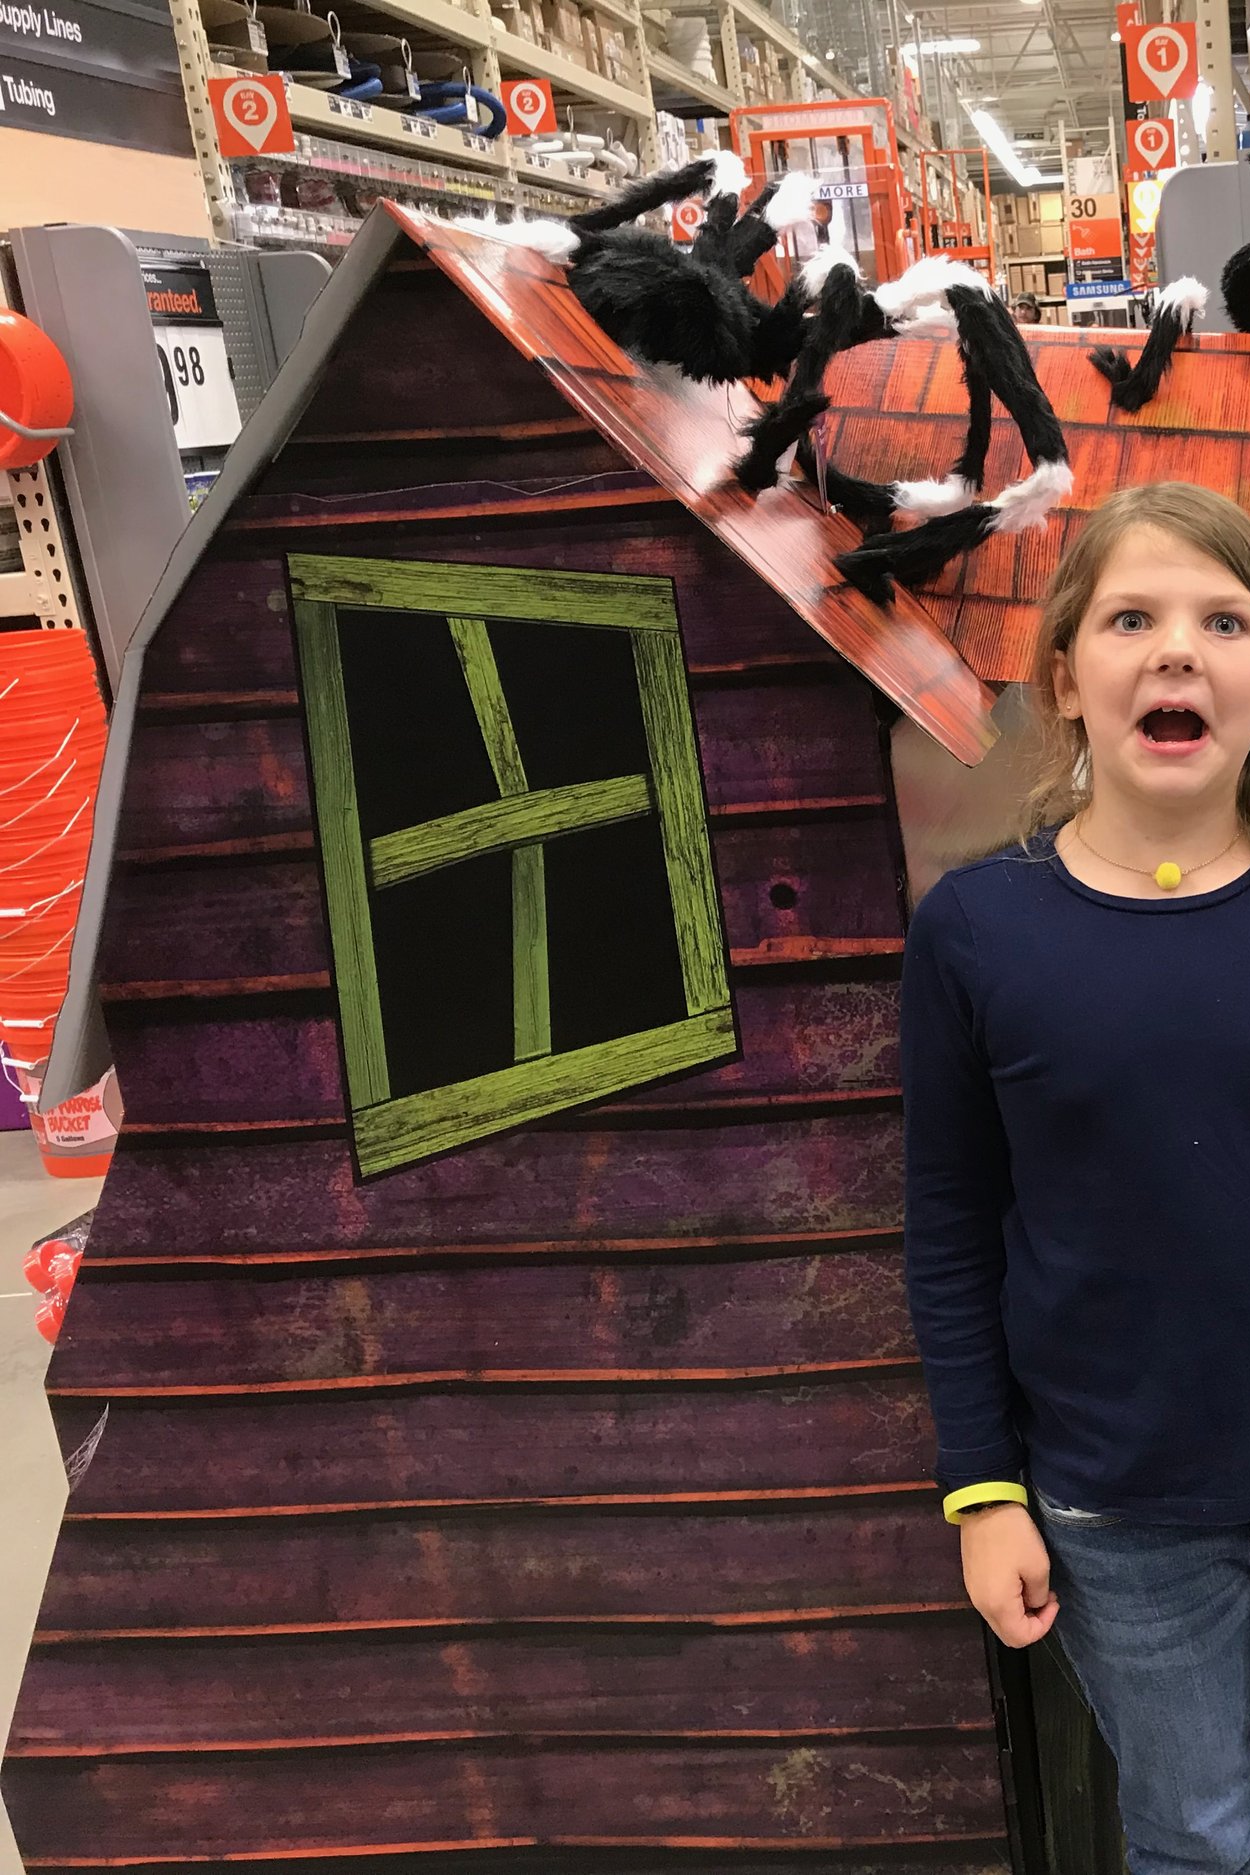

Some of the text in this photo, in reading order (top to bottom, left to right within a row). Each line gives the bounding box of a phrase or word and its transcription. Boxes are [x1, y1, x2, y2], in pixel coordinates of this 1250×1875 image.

[44, 8, 82, 43] Lines
[1156, 47, 1167, 66] 1
[2, 75, 56, 116] Tubing
[523, 97, 534, 111] 2
[242, 100, 260, 120] 2
[1147, 134, 1155, 147] 1
[1070, 198, 1097, 218] 30
[1072, 283, 1125, 297] SAMSUNG
[47, 1115, 90, 1133] BUCKET
